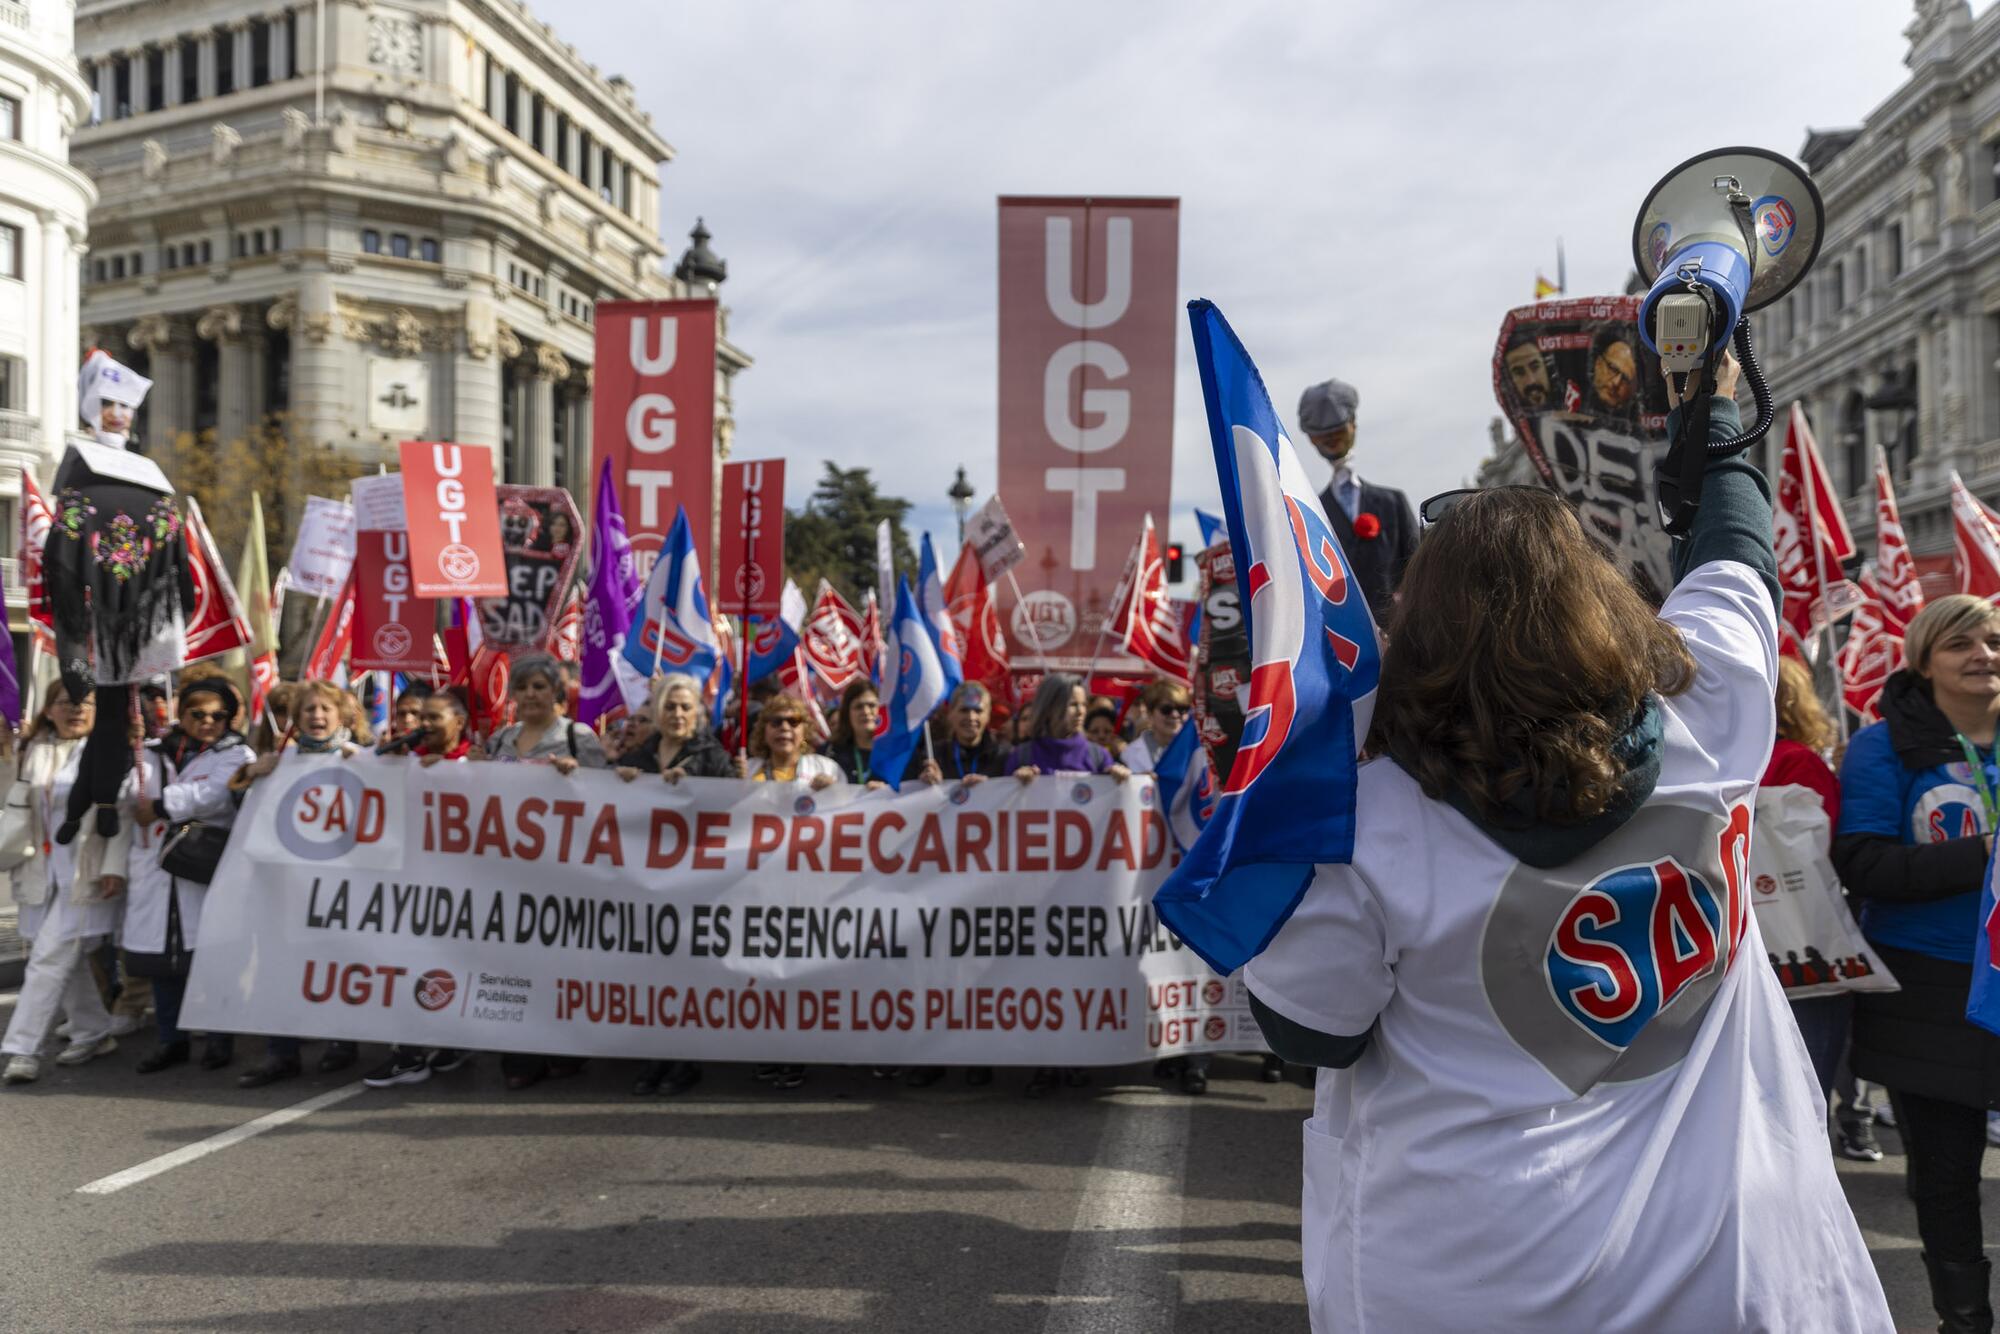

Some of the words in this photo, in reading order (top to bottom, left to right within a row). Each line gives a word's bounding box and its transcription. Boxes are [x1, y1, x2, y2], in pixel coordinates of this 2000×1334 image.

[1539, 307, 1561, 321] UGT
[1590, 305, 1612, 317] UGT
[1537, 337, 1561, 350] UGT
[1045, 216, 1132, 570] UGT
[626, 316, 678, 528] UGT
[432, 444, 467, 544] UGT
[383, 532, 409, 623] UGT
[482, 599, 549, 645] SAD
[299, 786, 387, 844] SAD
[423, 791, 625, 867] ¡BASTA
[646, 808, 731, 870] DE
[306, 877, 350, 931] LA
[358, 882, 475, 941] AYUDA
[483, 891, 506, 941] A
[514, 894, 680, 956] DOMICILIO
[691, 904, 731, 957] ES
[741, 906, 908, 958] ESENCIAL
[918, 908, 939, 957] Y
[950, 907, 1034, 957] DEBE
[1045, 906, 1108, 957] SER
[302, 960, 407, 1007] UGT
[476, 988, 529, 1004] Públicos
[479, 972, 532, 988] Servicios
[1148, 981, 1196, 1011] UGT
[472, 1006, 524, 1022] Madrid
[556, 977, 785, 1030] ¡PUBLICACIÓN
[797, 990, 840, 1031] DE
[851, 989, 915, 1031] LOS
[925, 987, 1063, 1031] PLIEGOS
[1073, 987, 1128, 1032] YA!
[1149, 1017, 1199, 1048] UGT
